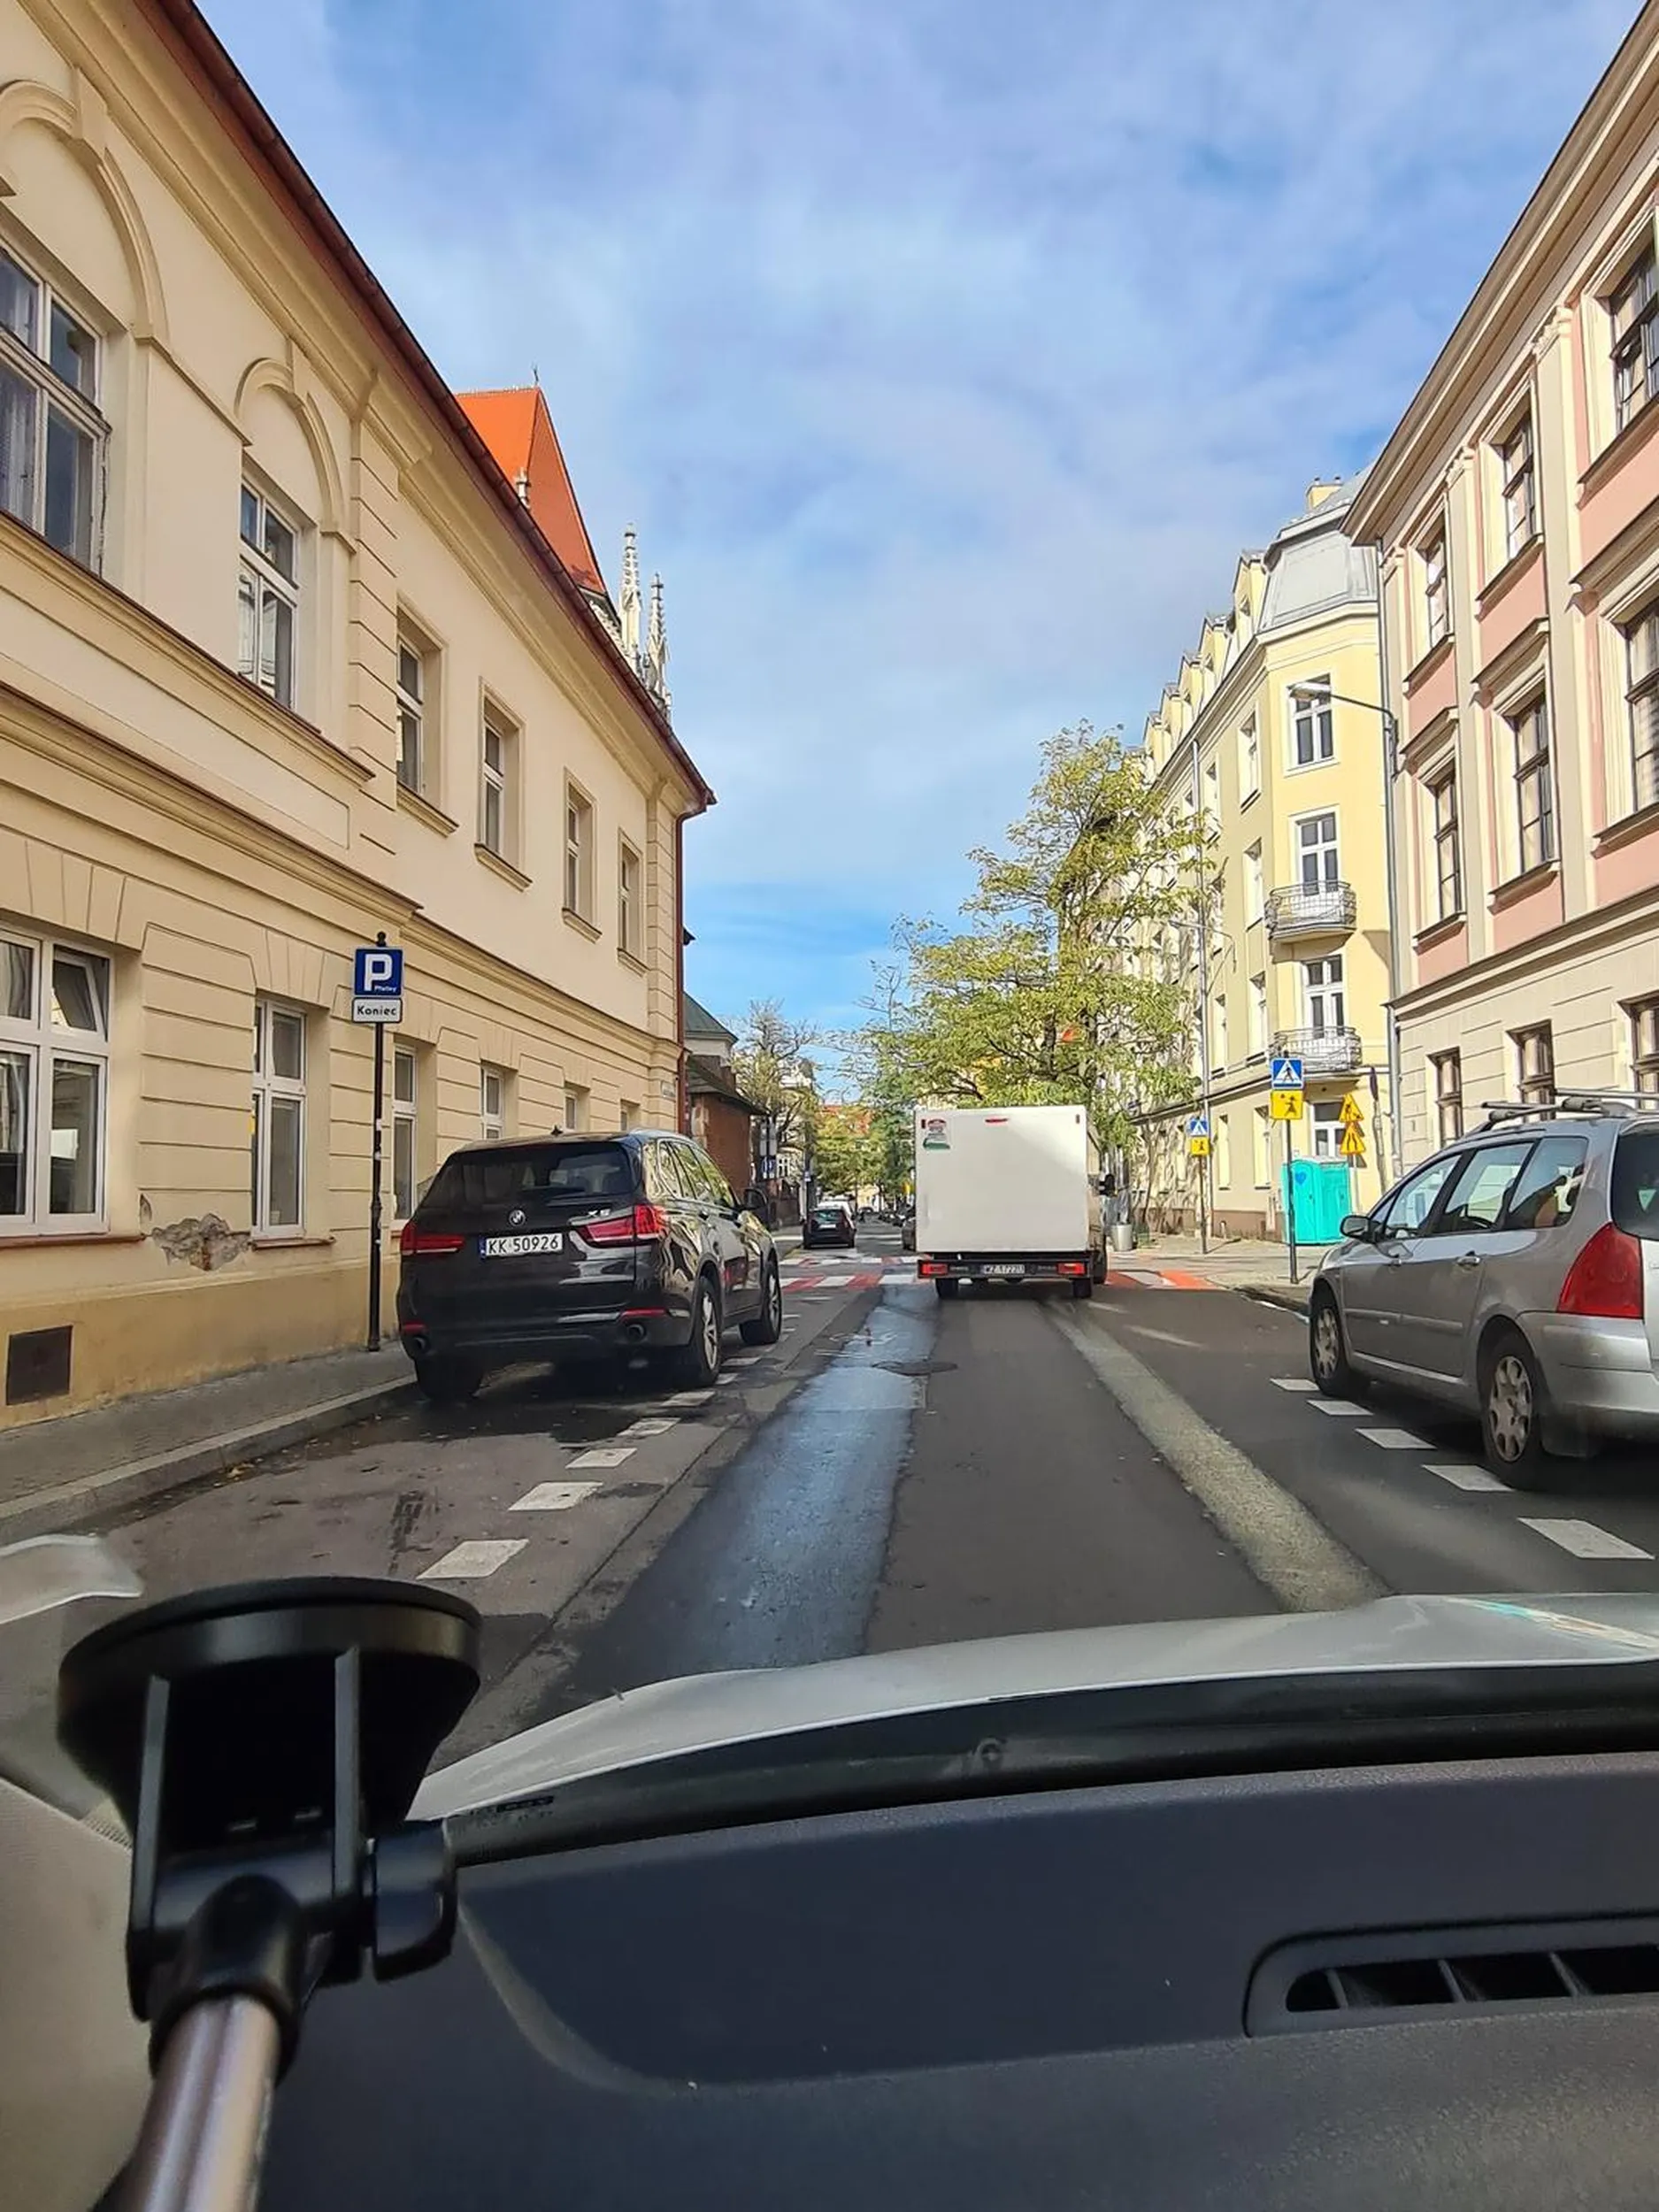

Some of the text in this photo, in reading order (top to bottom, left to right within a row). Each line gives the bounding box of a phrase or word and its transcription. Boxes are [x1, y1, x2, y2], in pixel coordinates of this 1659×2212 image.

[364, 954, 392, 991] P
[357, 1005, 396, 1016] Koniec
[489, 1235, 558, 1254] KK 50926
